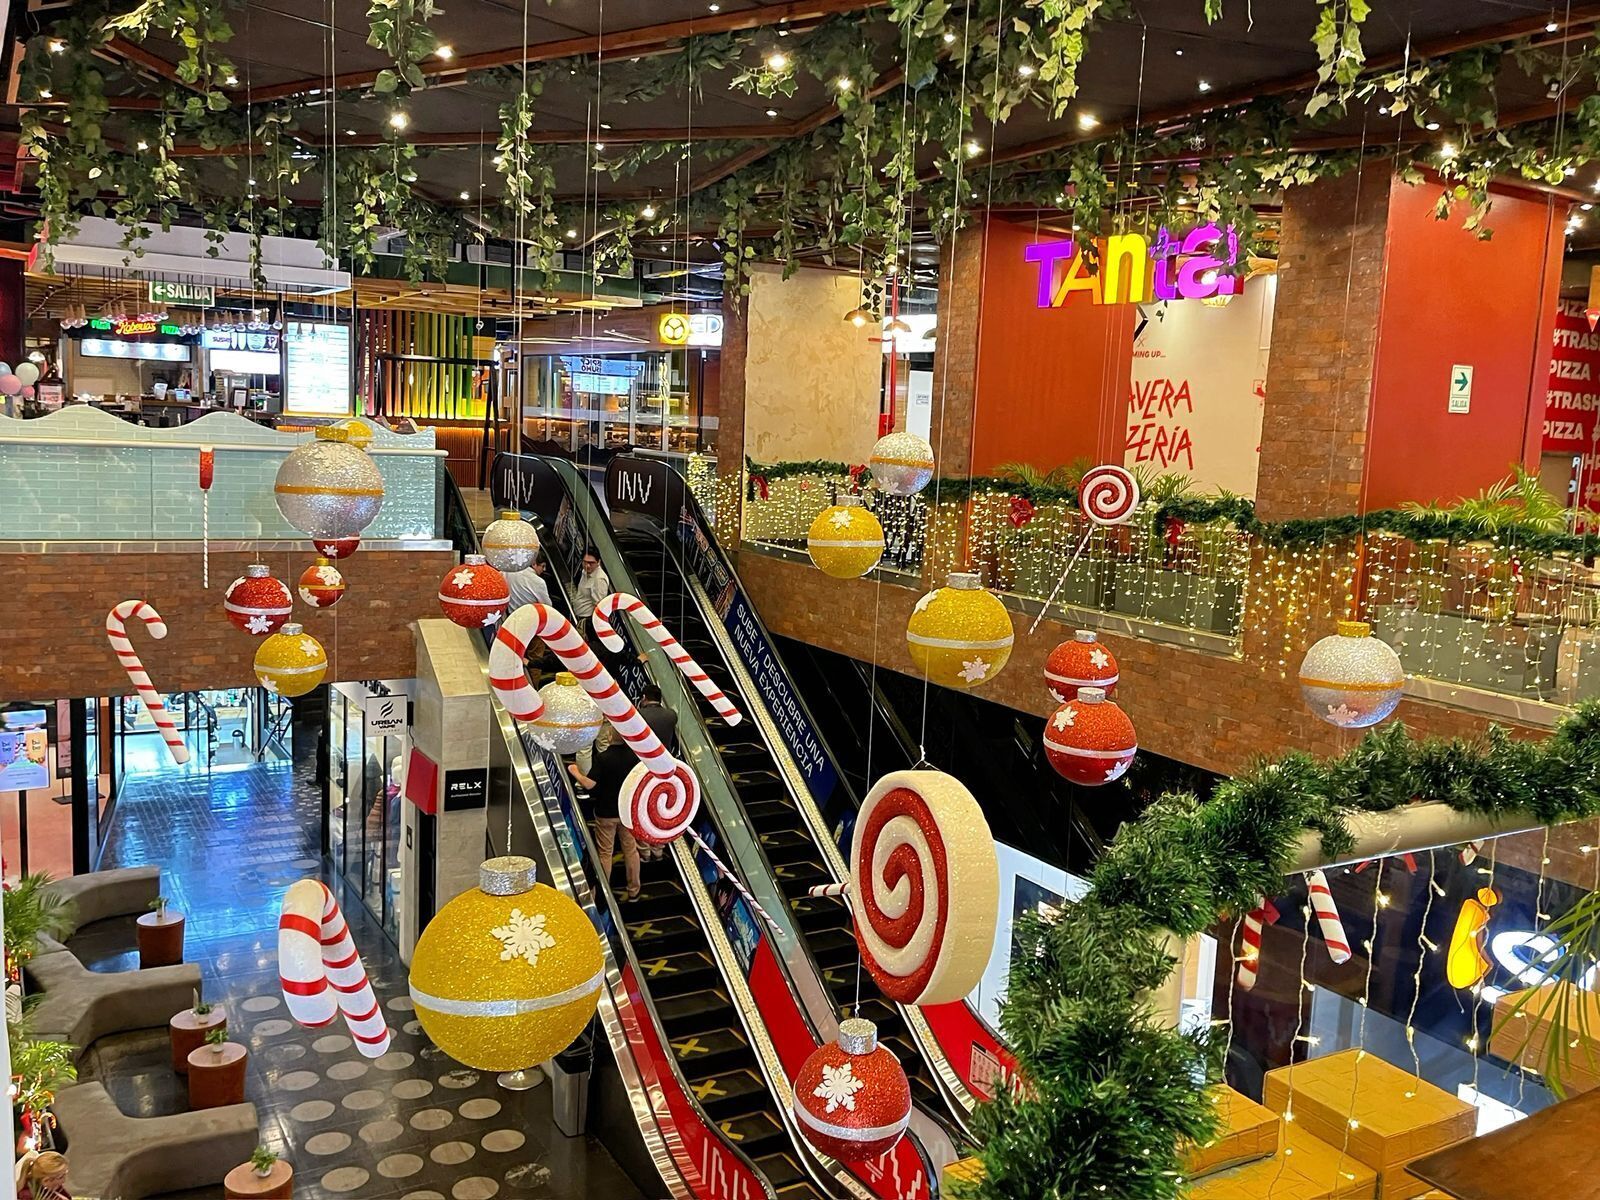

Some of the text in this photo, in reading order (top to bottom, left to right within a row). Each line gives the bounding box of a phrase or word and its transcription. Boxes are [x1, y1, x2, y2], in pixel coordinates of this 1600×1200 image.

[166, 283, 210, 300] SALIDA
[1553, 328, 1600, 351] #TRAS
[736, 603, 825, 772] SUBE Y DESCUBRE UNA
[734, 624, 813, 778] NUEVA EXPERIENCIA
[450, 781, 482, 791] RELX
